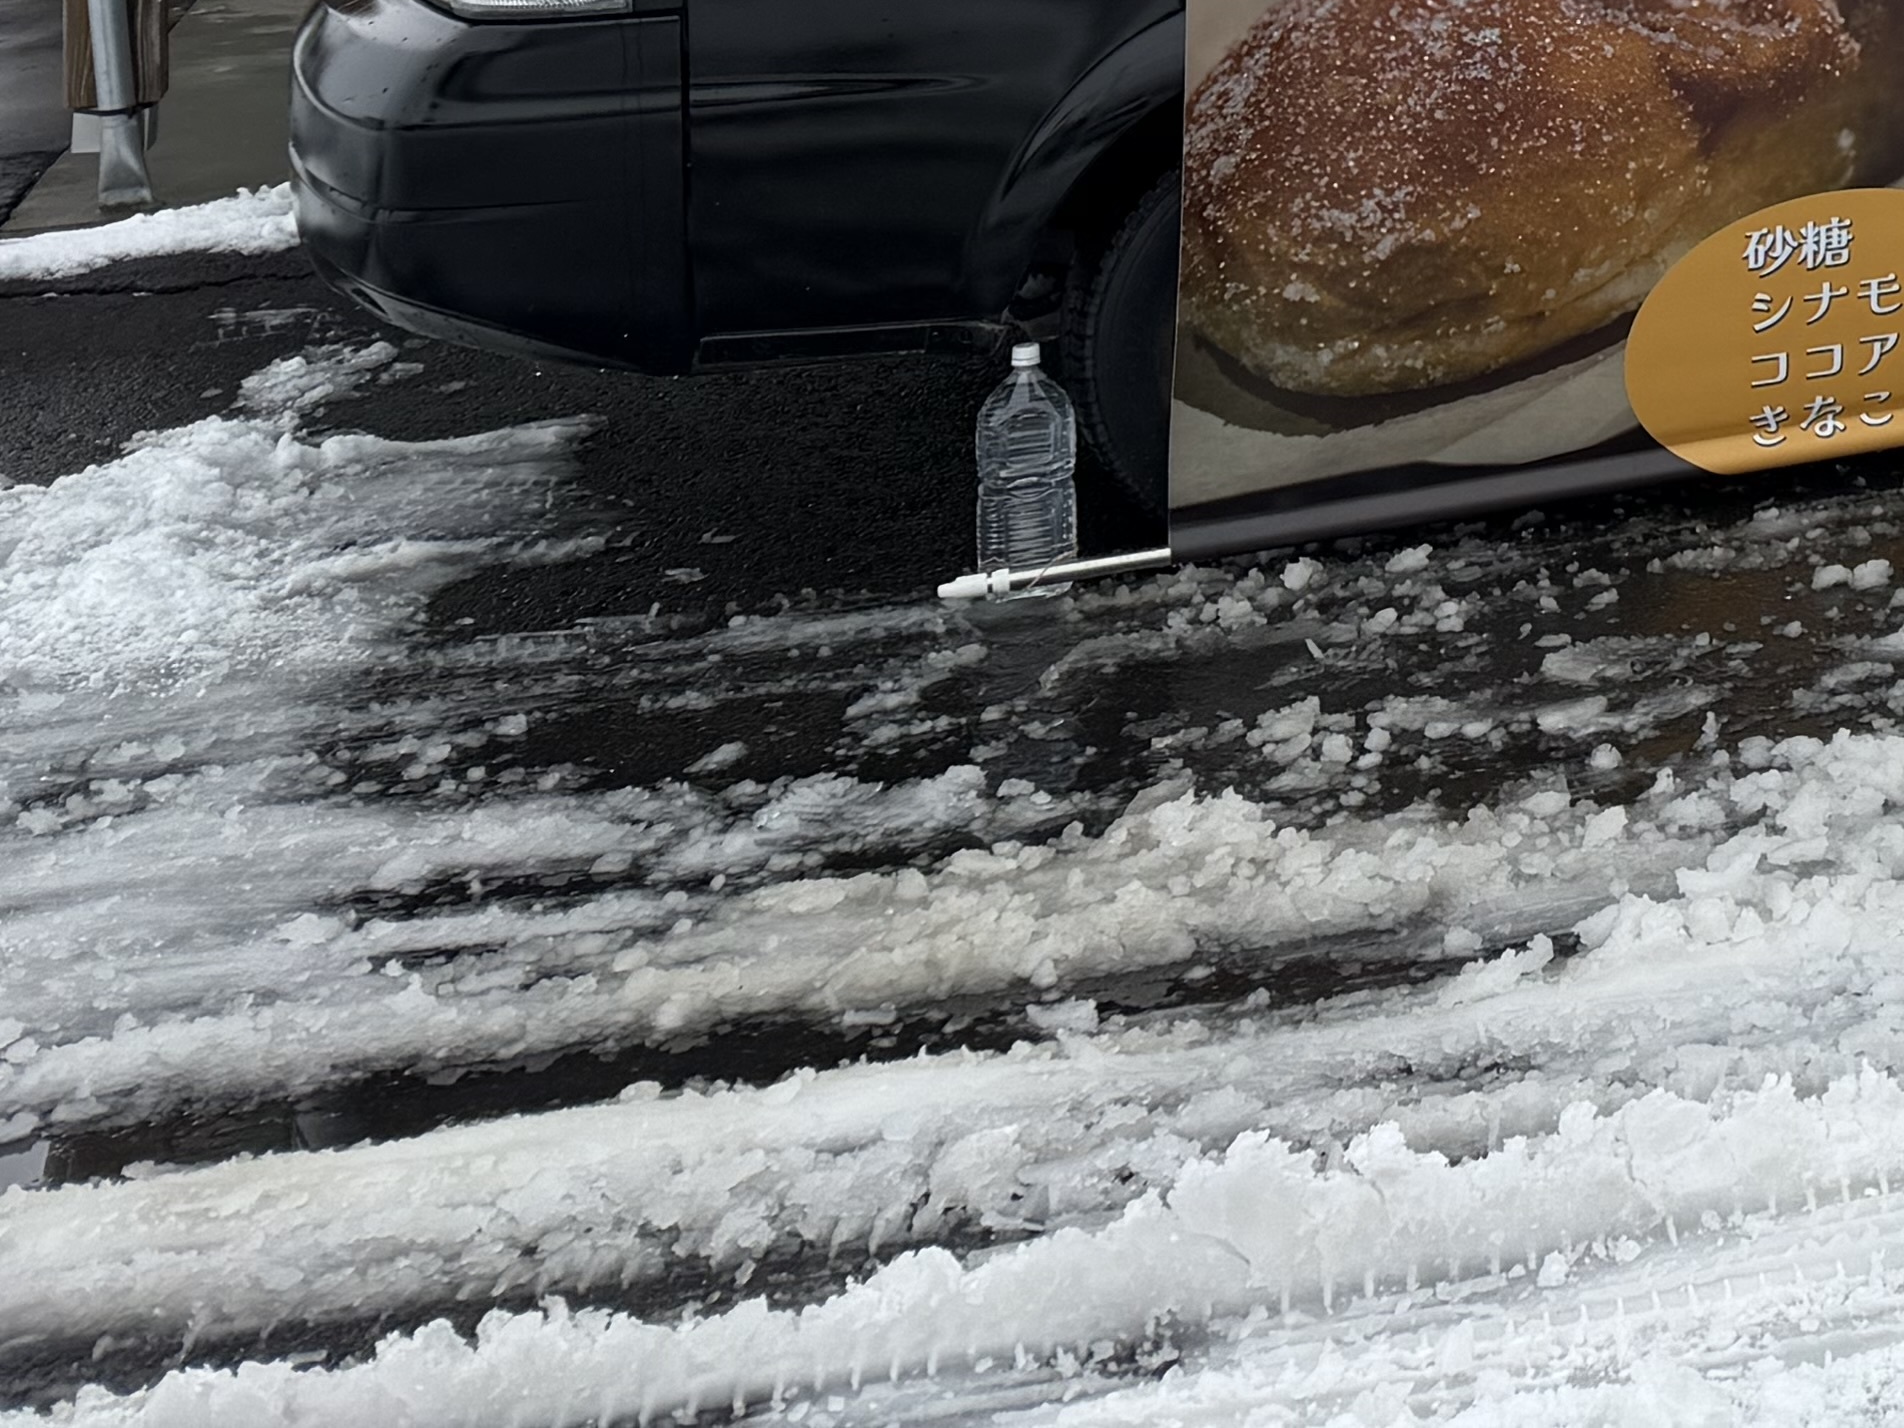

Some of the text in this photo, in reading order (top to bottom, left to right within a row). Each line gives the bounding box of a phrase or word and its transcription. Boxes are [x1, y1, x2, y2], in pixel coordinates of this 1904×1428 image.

[1741, 216, 1854, 278] 砂糖
[1750, 332, 1900, 388] ココア
[1749, 390, 1893, 447] きなこ
